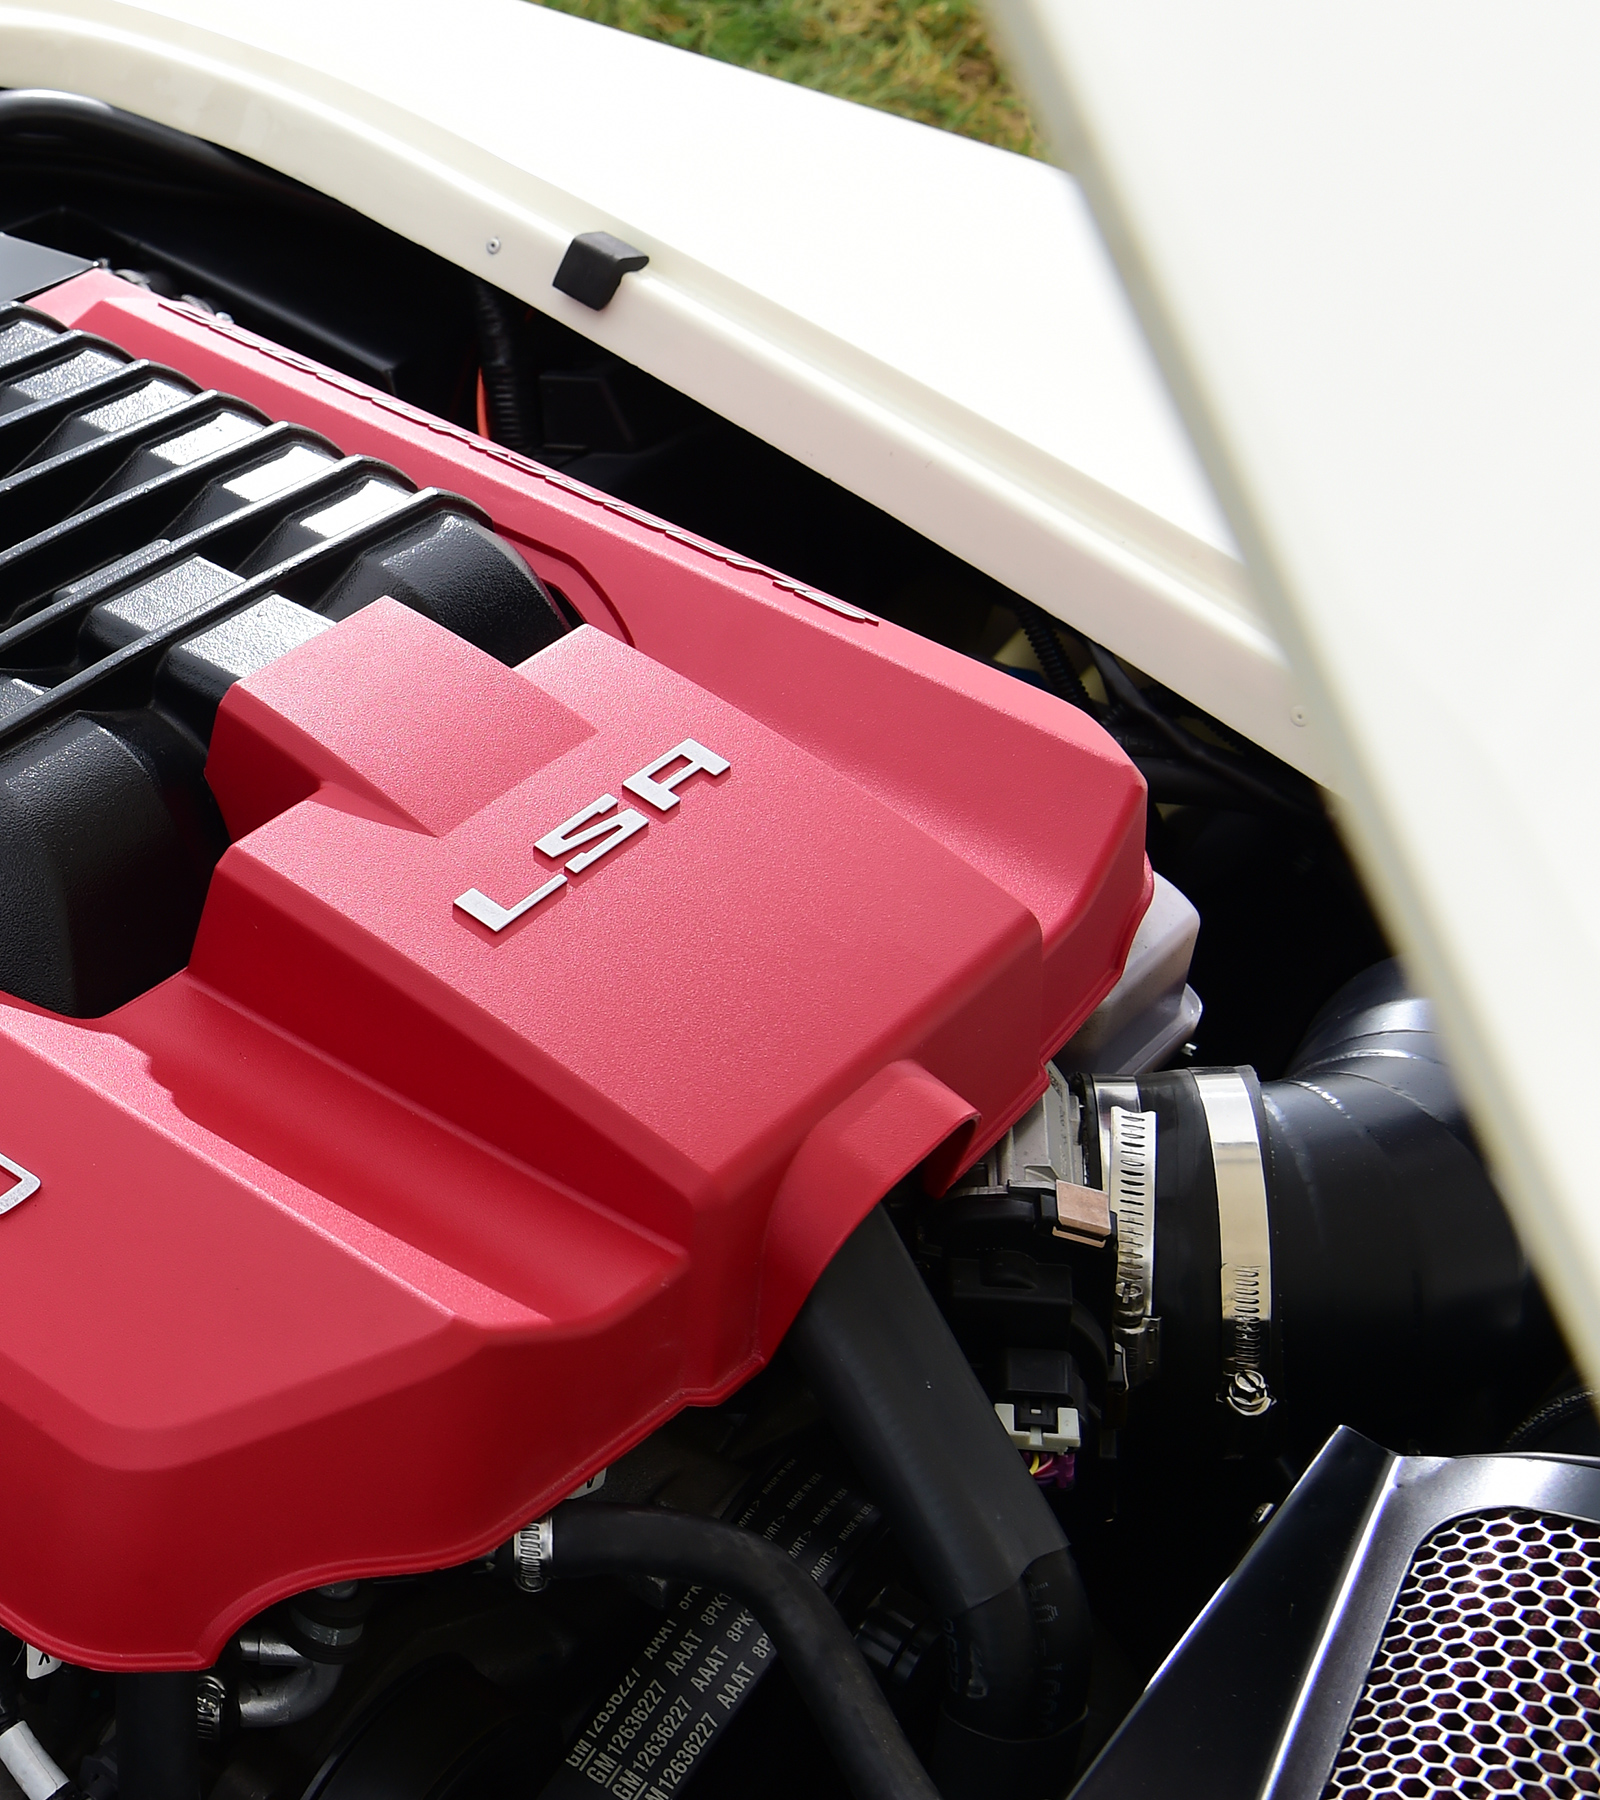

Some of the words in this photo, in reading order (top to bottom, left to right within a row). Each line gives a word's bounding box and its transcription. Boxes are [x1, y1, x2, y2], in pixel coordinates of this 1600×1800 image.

[453, 737, 732, 933] LSA
[586, 1750, 618, 1785] GM
[607, 1678, 667, 1756] 12636227
[664, 1628, 703, 1676] AAAT
[611, 1768, 643, 1800] GM
[632, 1695, 692, 1772] 12636227
[690, 1645, 729, 1693] AAAT
[658, 1712, 718, 1790] 12636227
[716, 1661, 755, 1709] AAAT
